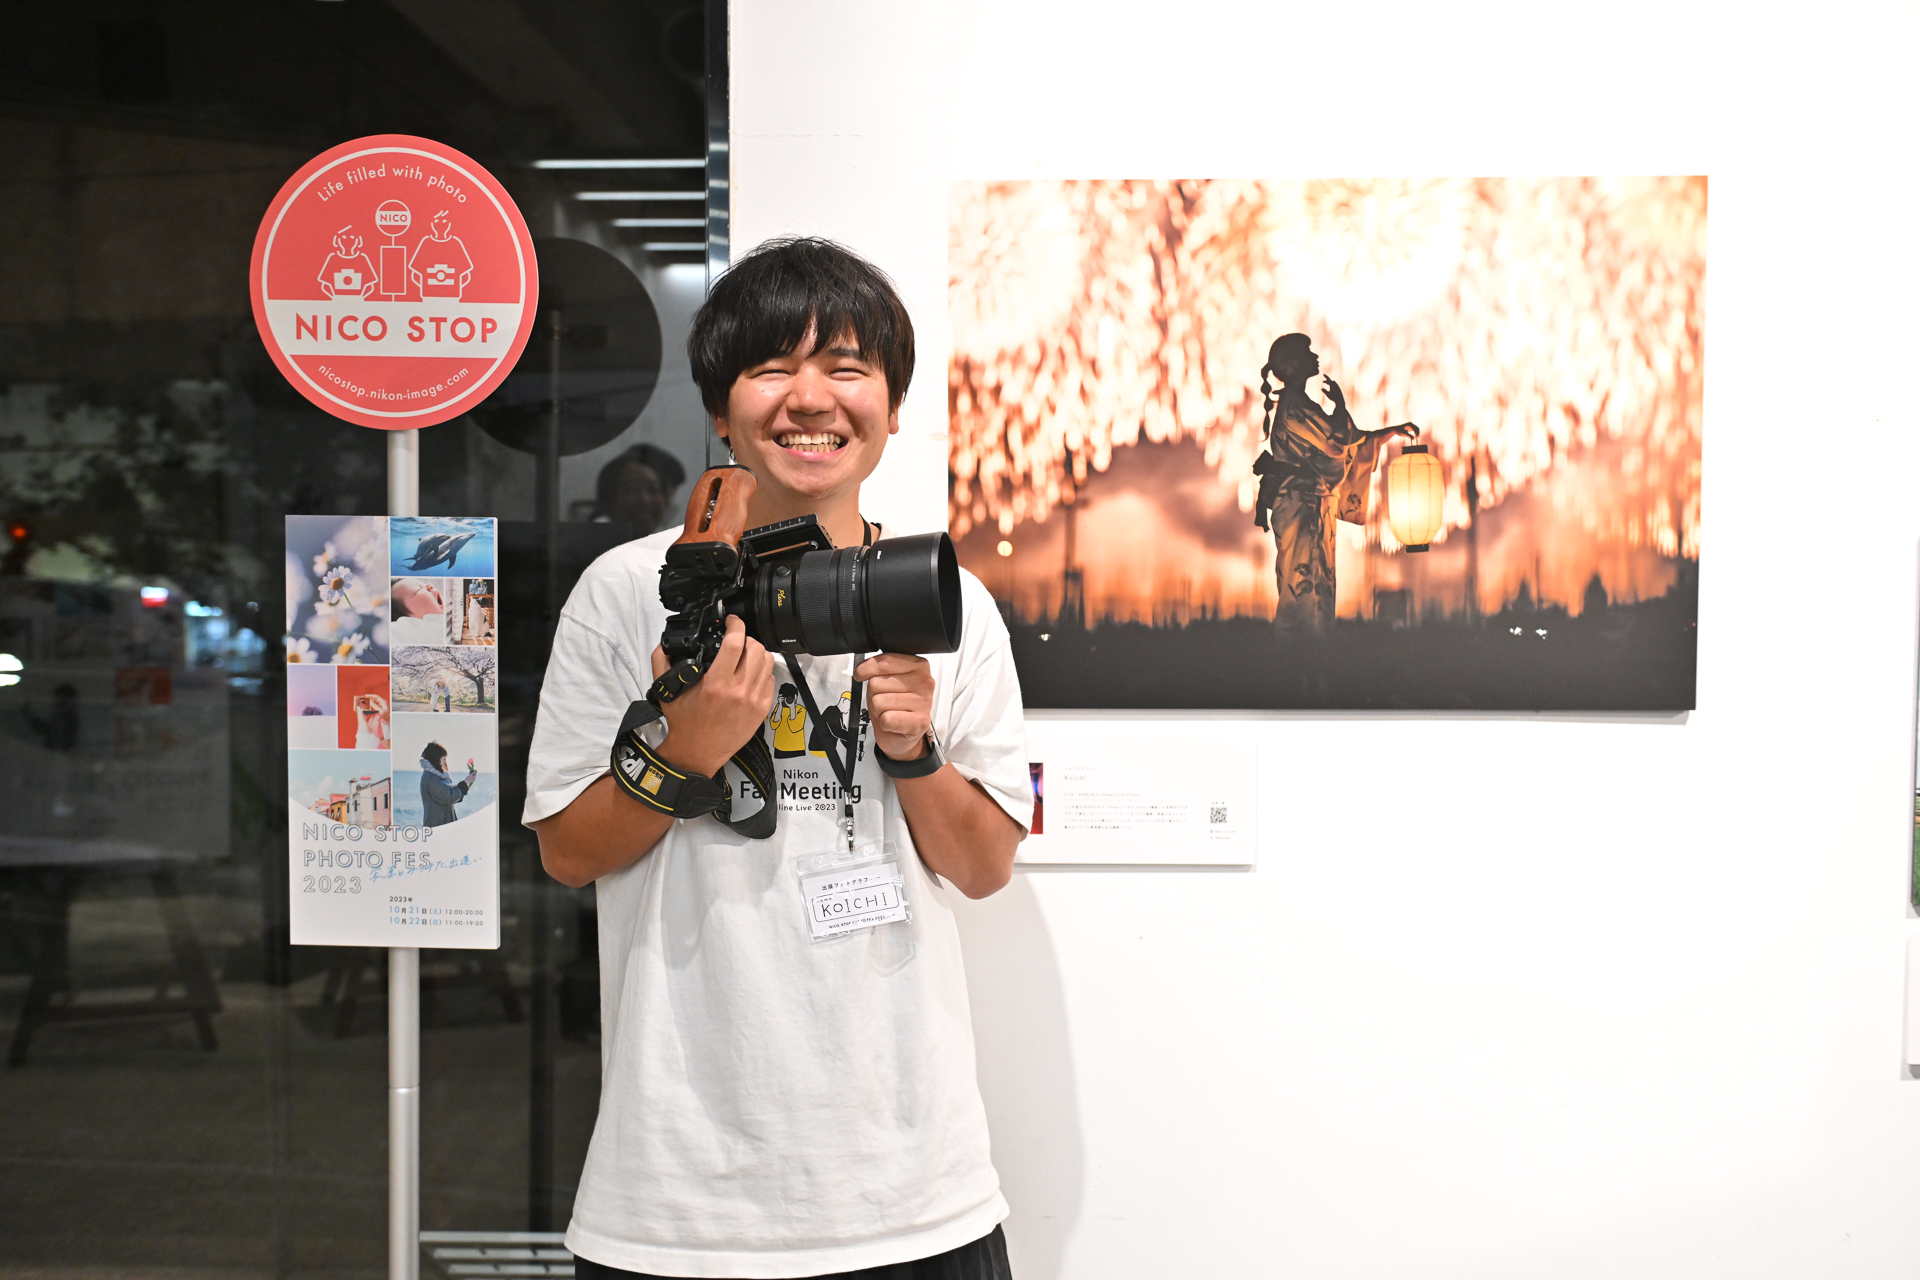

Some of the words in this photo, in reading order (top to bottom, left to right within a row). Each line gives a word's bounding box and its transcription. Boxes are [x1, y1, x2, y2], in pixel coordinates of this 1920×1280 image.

[316, 180, 345, 203] Life
[346, 163, 387, 185] filled
[392, 165, 424, 181] with
[426, 174, 468, 204] photo
[379, 213, 408, 223] NICO
[296, 312, 388, 342] NICO
[407, 316, 498, 344] STOP
[318, 363, 470, 401] nicostop.nikon-image.com
[648, 765, 665, 781] Nikon
[783, 769, 819, 780] Nikon
[740, 780, 762, 799] Fa
[796, 804, 812, 812] Live
[815, 803, 836, 811] 2023
[303, 822, 363, 842] NICO
[374, 824, 434, 843] STOP
[303, 849, 384, 869] PHOTO
[391, 851, 432, 869] FES
[303, 875, 363, 894] 2023
[822, 892, 888, 917] KOICHI
